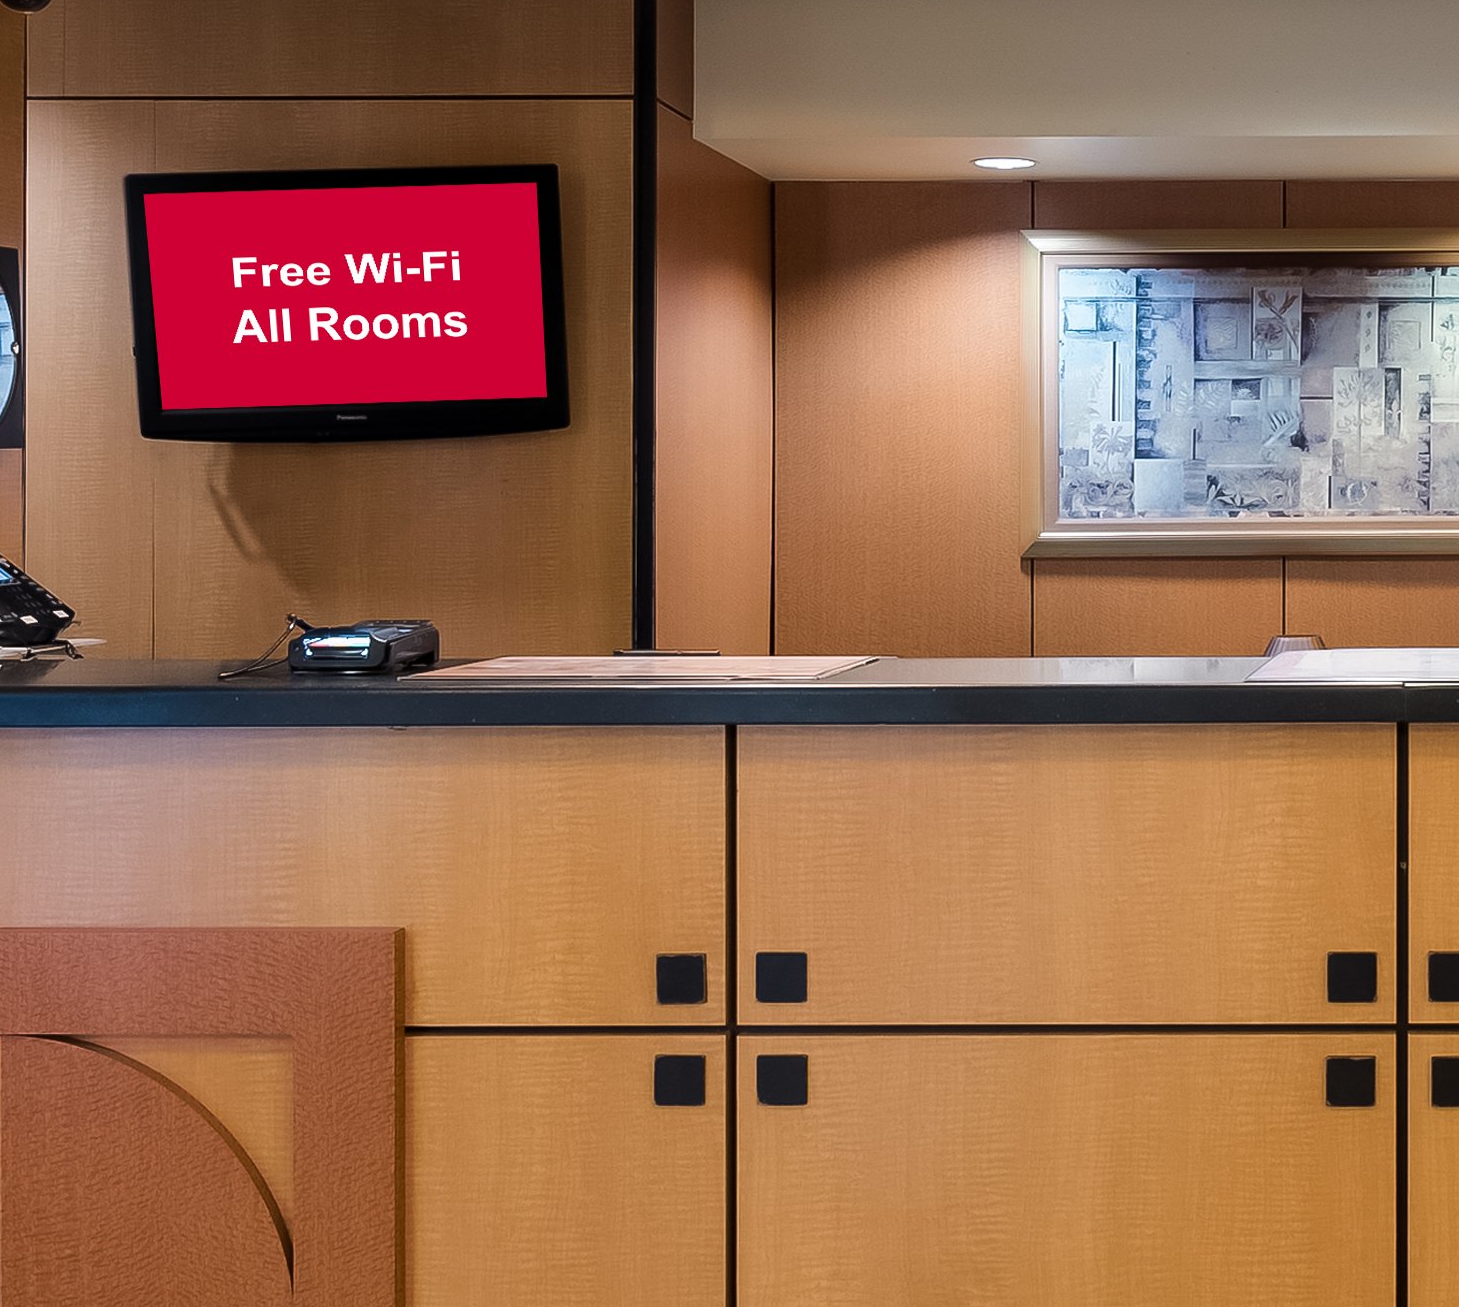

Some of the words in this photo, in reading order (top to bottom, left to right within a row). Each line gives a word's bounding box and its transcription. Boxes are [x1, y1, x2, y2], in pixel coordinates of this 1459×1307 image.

[232, 256, 331, 288] Free
[344, 250, 461, 285] Wi-Fi
[233, 307, 292, 344] All
[308, 306, 468, 342] Rooms
